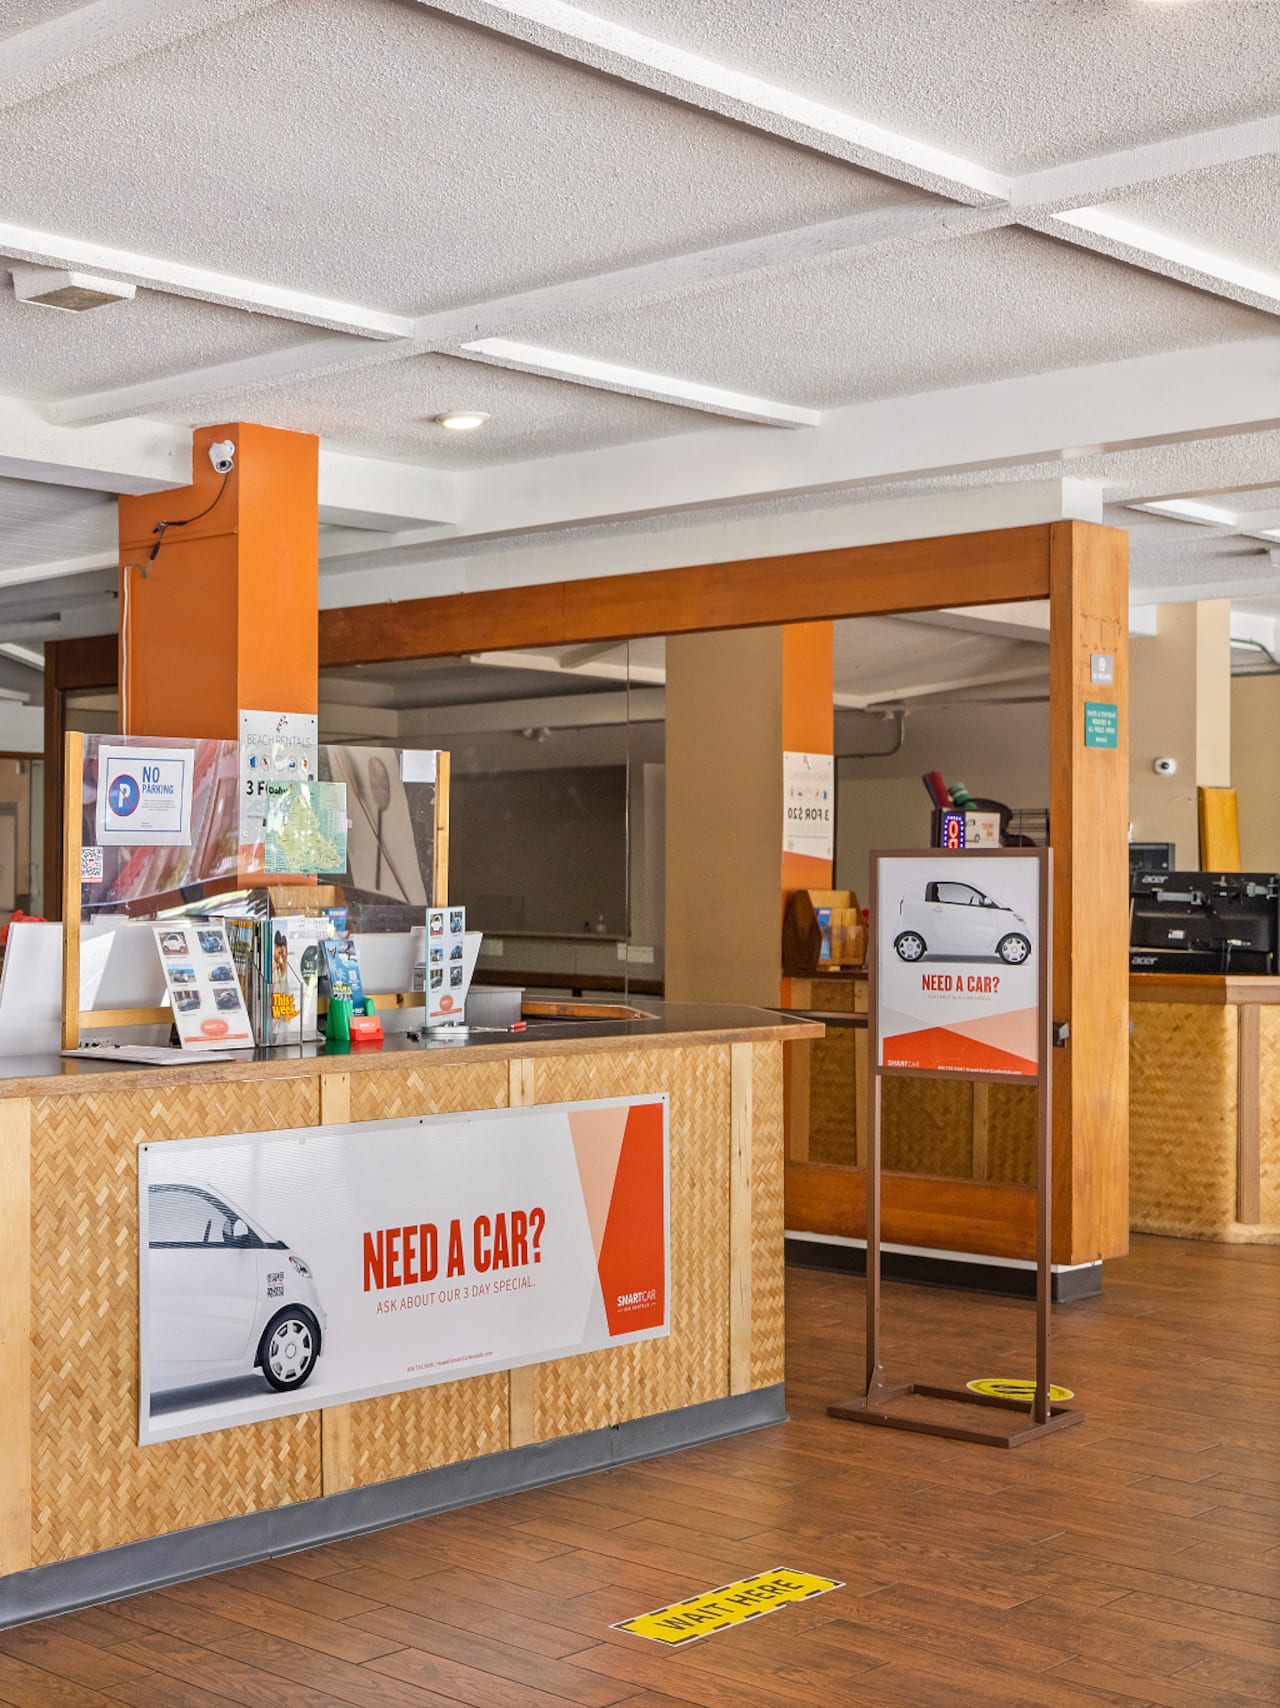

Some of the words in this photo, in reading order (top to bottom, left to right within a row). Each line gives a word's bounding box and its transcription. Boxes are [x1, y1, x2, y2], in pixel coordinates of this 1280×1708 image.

[247, 733, 274, 746] BEACH
[275, 736, 311, 748] RENTALS
[142, 766, 160, 783] NO
[142, 784, 174, 794] PARKING
[246, 780, 254, 795] 3
[1142, 875, 1168, 883] acer
[1131, 956, 1158, 965] acer
[922, 974, 952, 991] NEED
[956, 976, 963, 992] A
[967, 976, 1000, 993] CAR?
[272, 993, 291, 1006] This
[887, 1059, 920, 1067] SMARTCAR
[363, 1223, 438, 1292] NEED
[446, 1219, 465, 1278] A
[473, 1207, 546, 1273] CAR?
[376, 1299, 397, 1314] ASK
[400, 1292, 436, 1311] ABOUT
[438, 1288, 460, 1304] OUR
[463, 1287, 470, 1299] 3
[472, 1283, 491, 1298] DAY
[493, 1276, 536, 1294] SPECIAL.
[617, 1289, 656, 1307] SMARTCAR
[654, 1603, 734, 1631] WAIT
[725, 1579, 803, 1607] HERE
